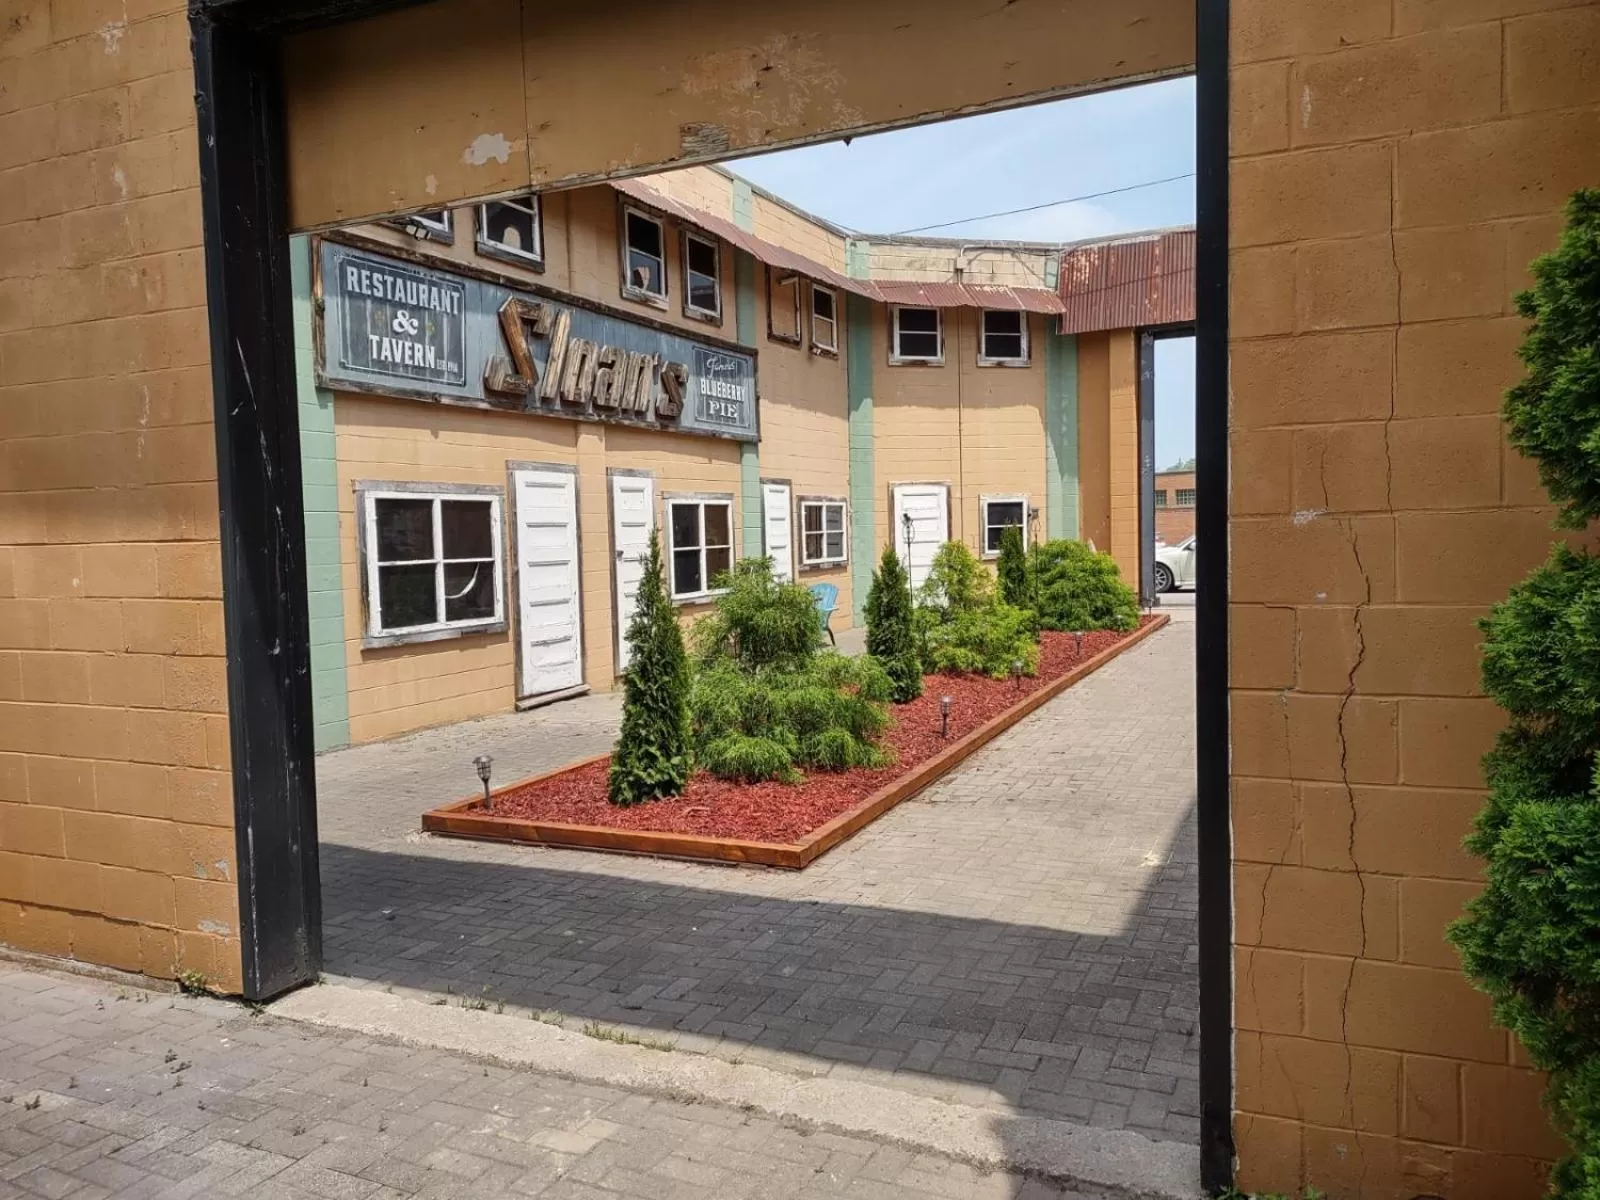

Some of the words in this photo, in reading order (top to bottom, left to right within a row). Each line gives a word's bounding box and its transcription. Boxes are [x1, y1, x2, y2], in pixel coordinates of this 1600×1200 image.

[346, 266, 460, 315] RESTAURANT
[392, 309, 419, 336] &
[369, 335, 436, 369] TAVERN
[484, 295, 689, 417] Sloan's
[700, 377, 746, 402] BLUEBERRY
[708, 400, 738, 418] PIE
